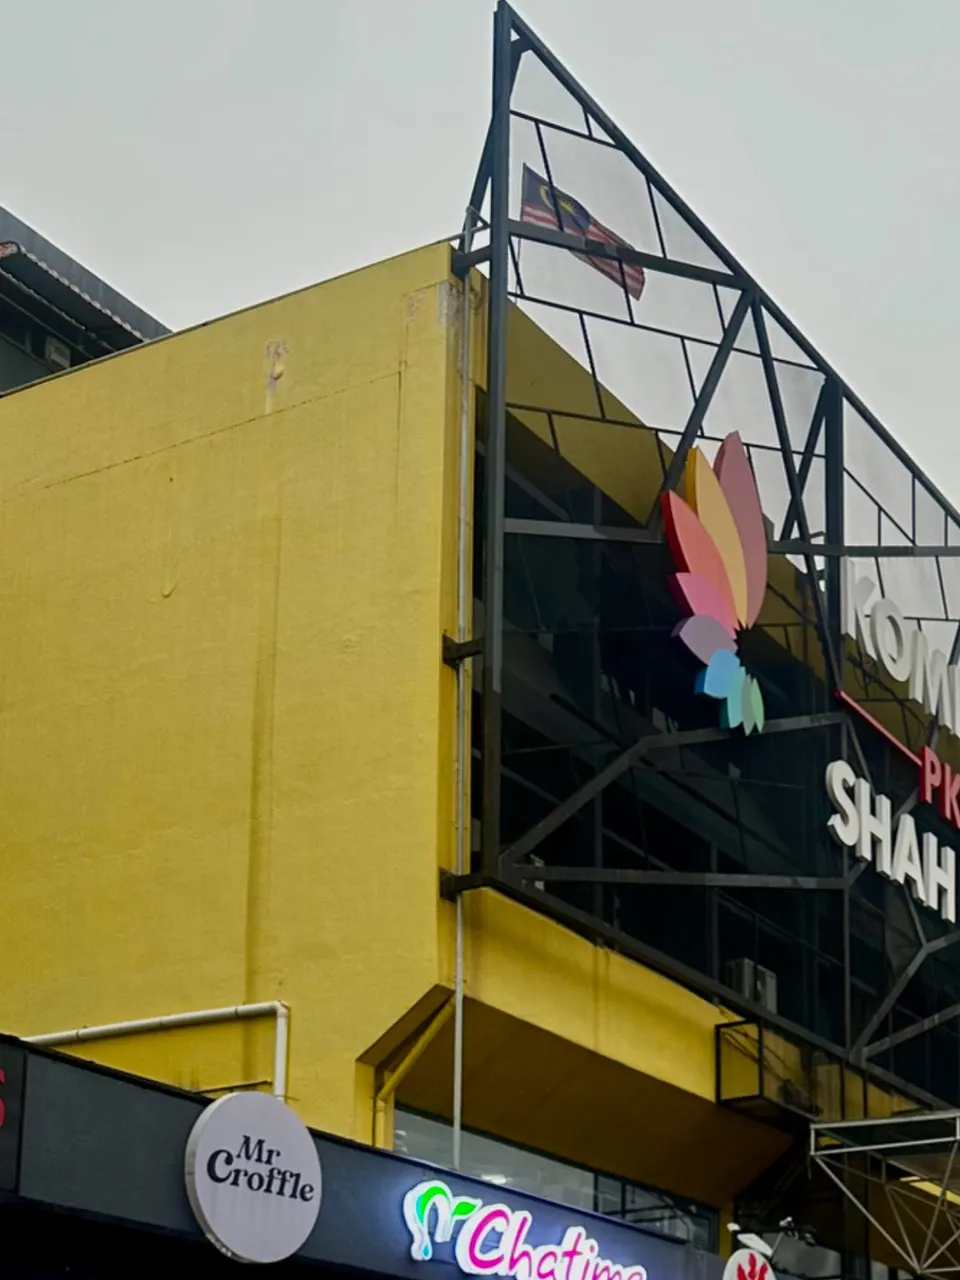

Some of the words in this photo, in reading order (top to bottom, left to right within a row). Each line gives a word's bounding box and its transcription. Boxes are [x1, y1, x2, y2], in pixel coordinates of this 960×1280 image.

[825, 759, 957, 923] SHAH
[207, 1149, 314, 1202] Croffle
[236, 1134, 281, 1166] Mr
